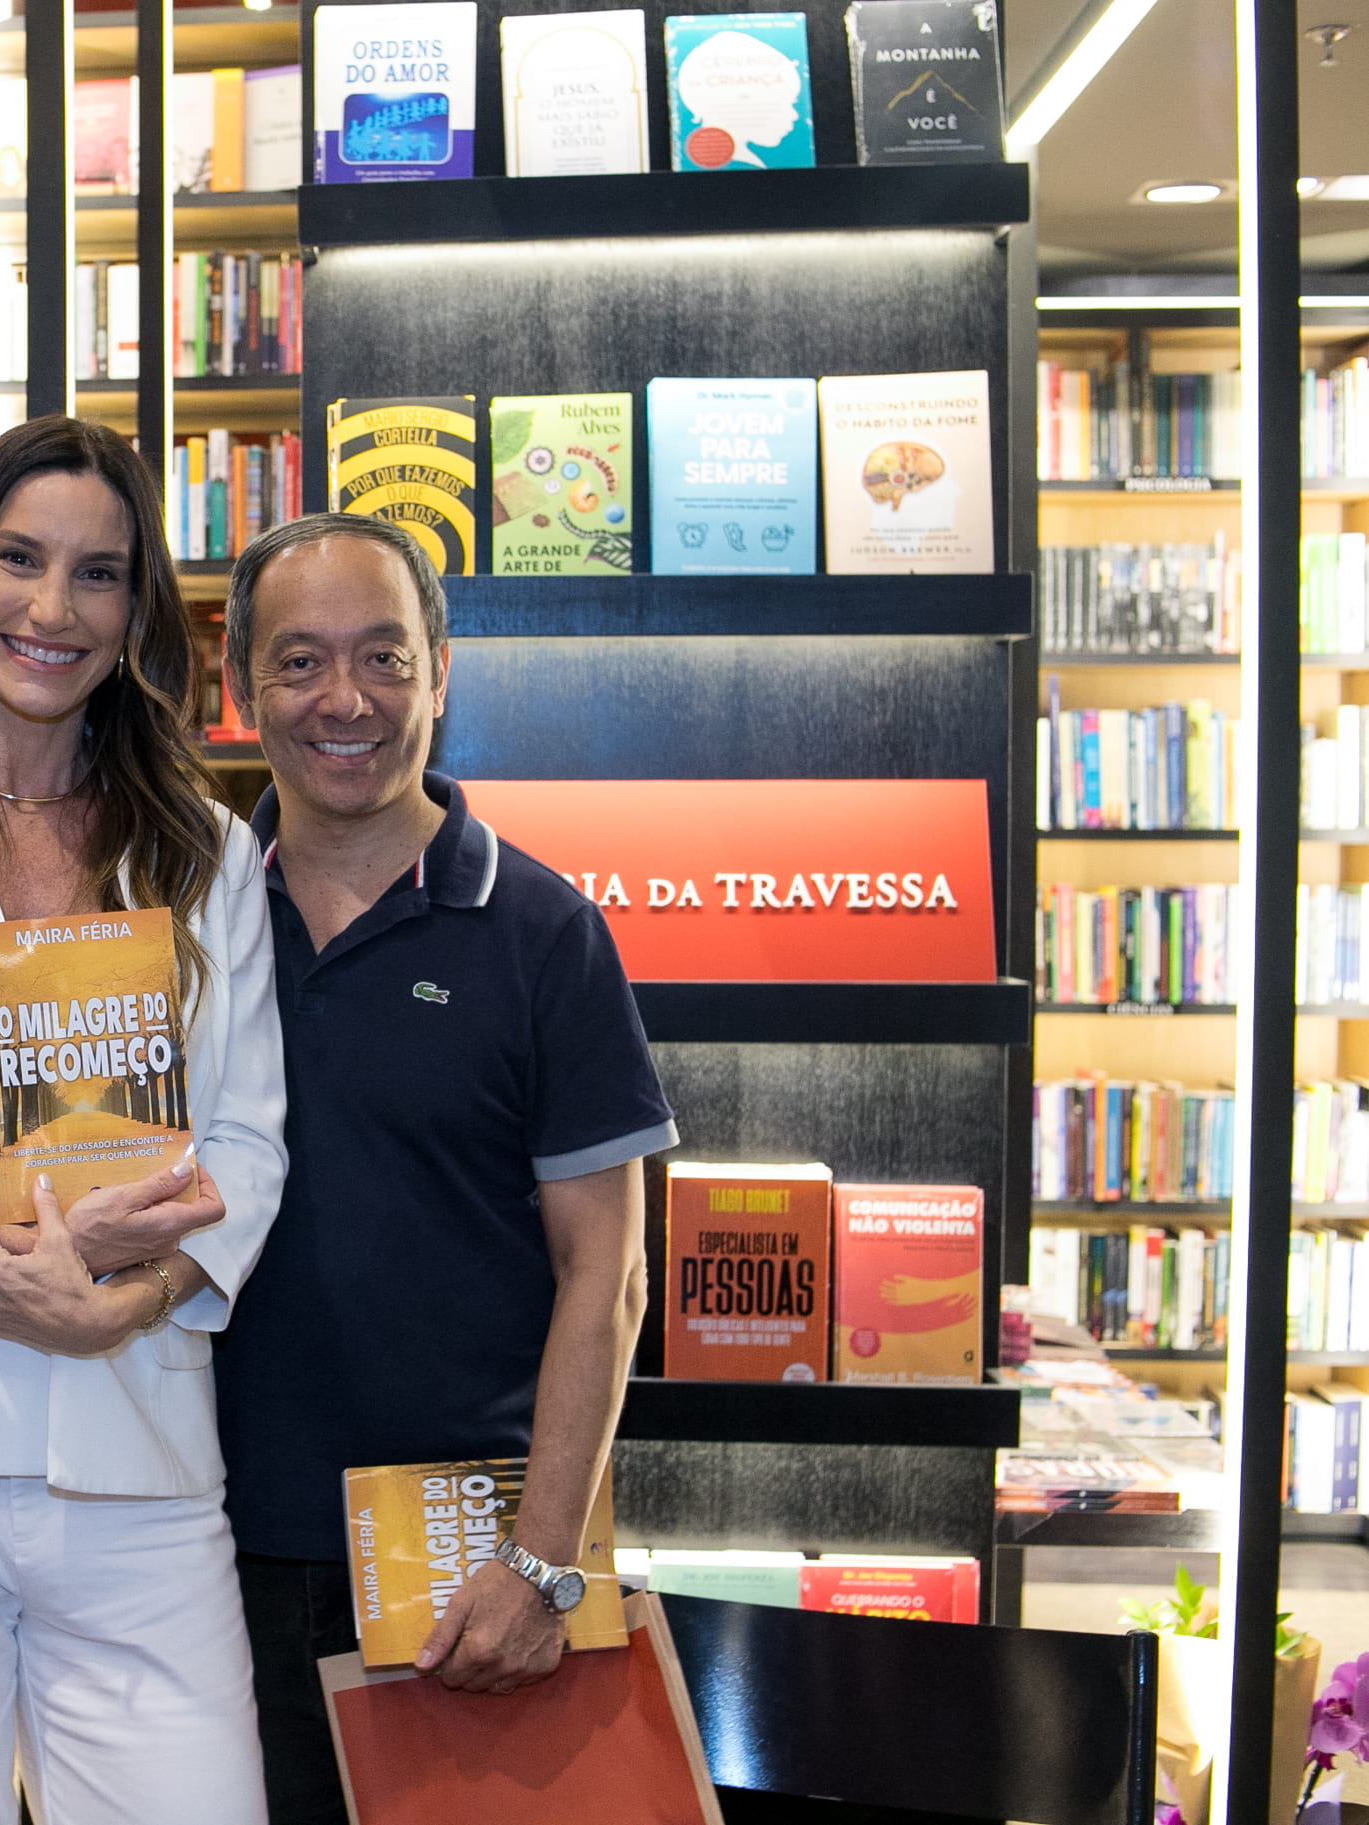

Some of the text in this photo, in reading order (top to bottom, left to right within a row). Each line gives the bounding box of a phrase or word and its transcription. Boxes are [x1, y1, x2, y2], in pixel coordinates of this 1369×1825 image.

[919, 22, 933, 34] A
[353, 39, 443, 60] ORDENS
[875, 47, 981, 63] MONTANHA
[345, 63, 450, 83] DO AMOR
[907, 112, 958, 130] VOCÊ
[561, 403, 620, 418] Rubem
[835, 397, 979, 414] DESCONSTRUINDO
[578, 420, 621, 435] Alves
[687, 411, 785, 435] JOVEM
[836, 420, 848, 430] O
[913, 416, 933, 428] DA
[937, 414, 979, 426] FOME
[373, 427, 438, 446] CORTELLA
[700, 437, 771, 460] PARA
[346, 465, 466, 498] POR QUE FAZEMOS
[683, 461, 788, 485] SEMPRE
[386, 484, 425, 502] O QUE
[503, 544, 581, 557] A GRANDE
[503, 560, 562, 572] ARTE DE
[647, 877, 703, 907] DA
[713, 872, 958, 909] TRAVESSA
[15, 920, 133, 947] MAIRA FÉRIA
[17, 993, 140, 1042] MILAGRE
[143, 991, 169, 1023] DO
[0, 1034, 172, 1087] RECOMEÇO
[13, 1134, 174, 1158] LIBERTE-SE DO PASSADO E ENCONTRE A
[24, 1156, 66, 1168] CORAGEM
[66, 1154, 88, 1164] PARA
[89, 1151, 105, 1162] SER
[106, 1149, 132, 1161] QUEM
[709, 1188, 743, 1213] TIAGO
[848, 1199, 977, 1220] COMUNICAÇÃO
[848, 1216, 976, 1237] NÃO VIOLENTA
[698, 1231, 799, 1255] ESPECIALISTA EM
[680, 1257, 814, 1317] PESSOAS
[421, 1476, 449, 1500] DO
[356, 1507, 383, 1620] MAIRA FÉRIA
[830, 1593, 925, 1609] QUEBRANDO O
